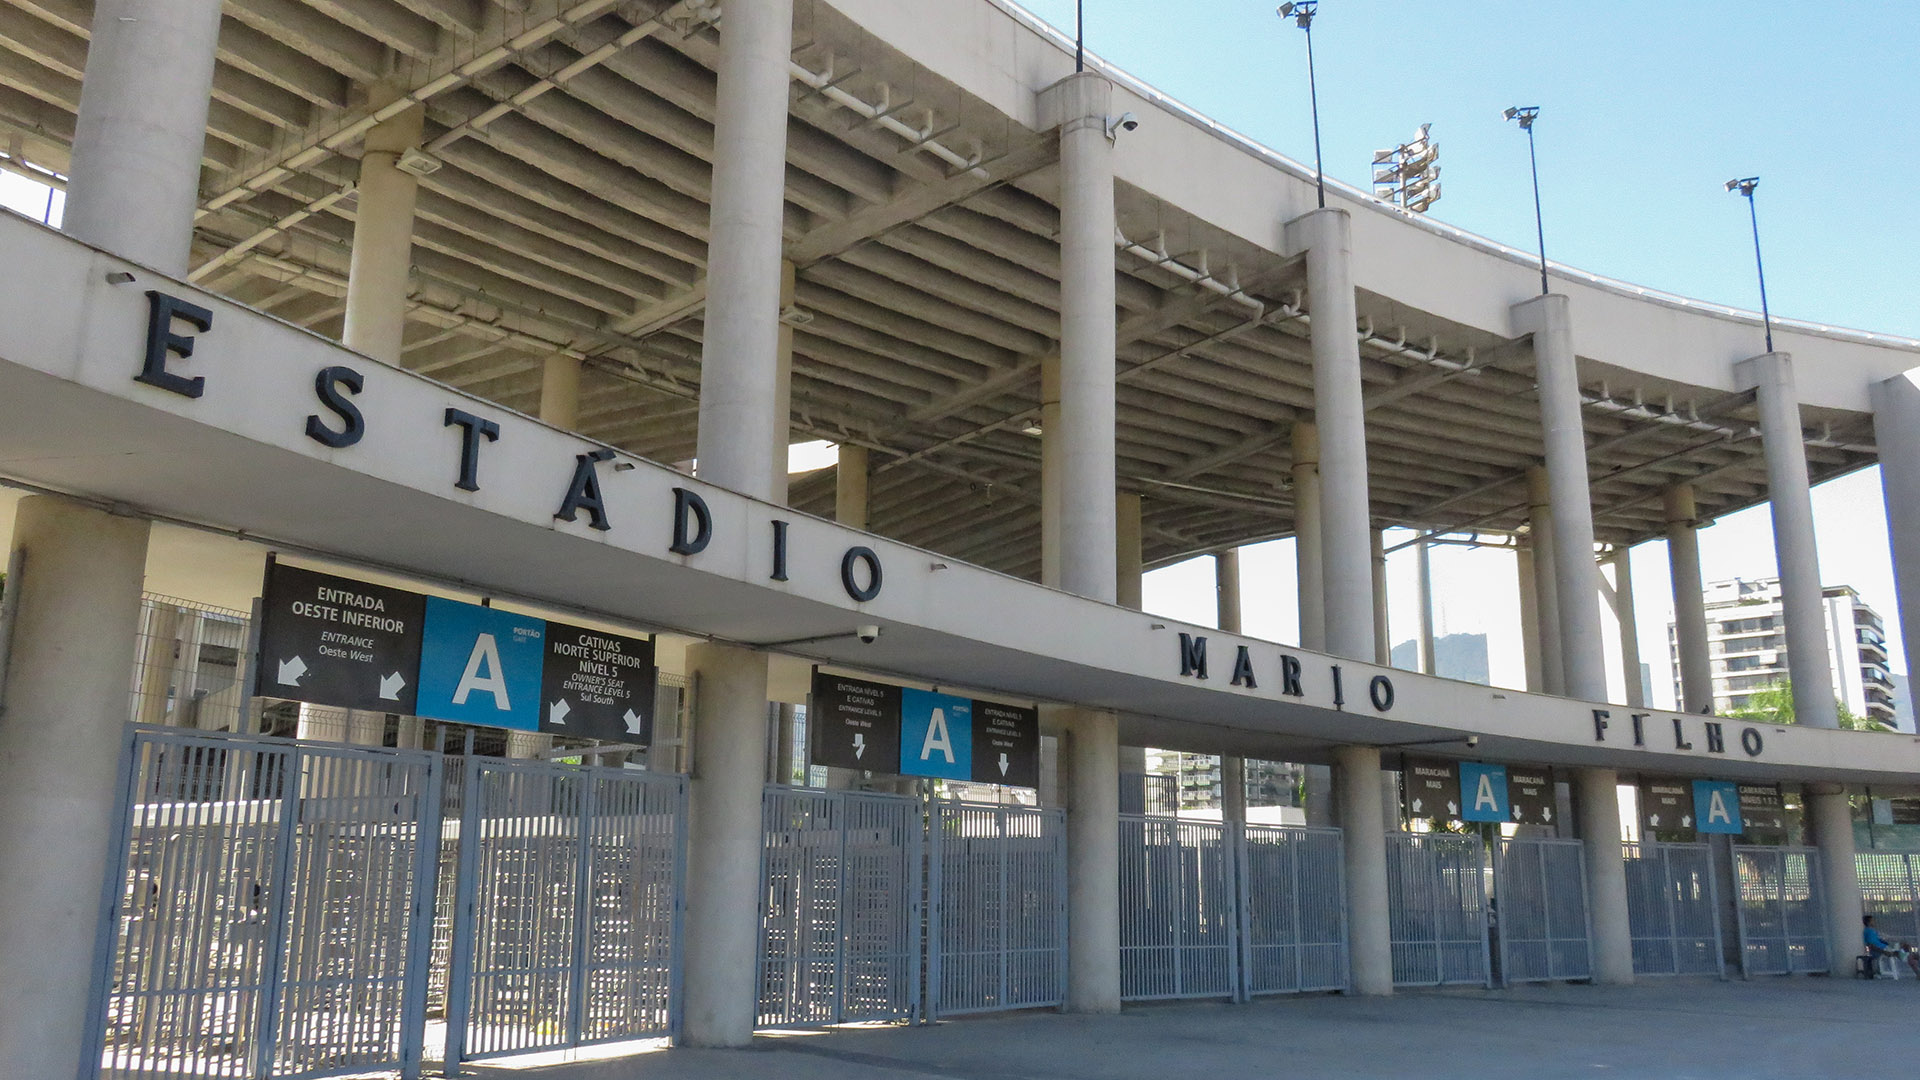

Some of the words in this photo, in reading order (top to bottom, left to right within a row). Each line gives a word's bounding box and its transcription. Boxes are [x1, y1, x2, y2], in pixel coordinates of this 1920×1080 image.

[134, 291, 884, 601] ESTÁDIO
[1178, 633, 1395, 712] MARIO
[1592, 709, 1764, 757] FILHO
[318, 586, 384, 612] ENTRADA
[292, 601, 338, 622] OESTE
[342, 611, 404, 634] INFERIOR
[321, 631, 374, 649] ENTRANCE
[513, 627, 540, 638] PORTÃO
[579, 634, 621, 652] CATIVAS
[319, 645, 347, 658] Oeste
[350, 650, 373, 663] West
[554, 642, 589, 659] NORTE
[592, 649, 640, 669] SUPERIOR
[452, 632, 511, 711] A
[579, 660, 609, 676] NÍVEL
[612, 666, 618, 678] 5
[563, 680, 602, 694] ENTRANCE
[604, 687, 625, 698] LEVEL
[626, 690, 631, 699] 5
[571, 673, 606, 686] OWNER'S
[607, 678, 625, 688] SEAT
[838, 683, 863, 694] ENTRADA
[581, 692, 592, 702] Sul
[593, 694, 615, 705] South
[852, 696, 874, 706] CATIVAS
[838, 705, 863, 714] ENTRANCE
[920, 707, 955, 763] A
[1415, 767, 1451, 778] MARACANÃ
[1513, 775, 1545, 785] MARACANÃ
[1426, 780, 1442, 789] MAIS
[1475, 774, 1498, 812] A
[1523, 788, 1538, 796] MAIS
[1708, 790, 1731, 824] A
